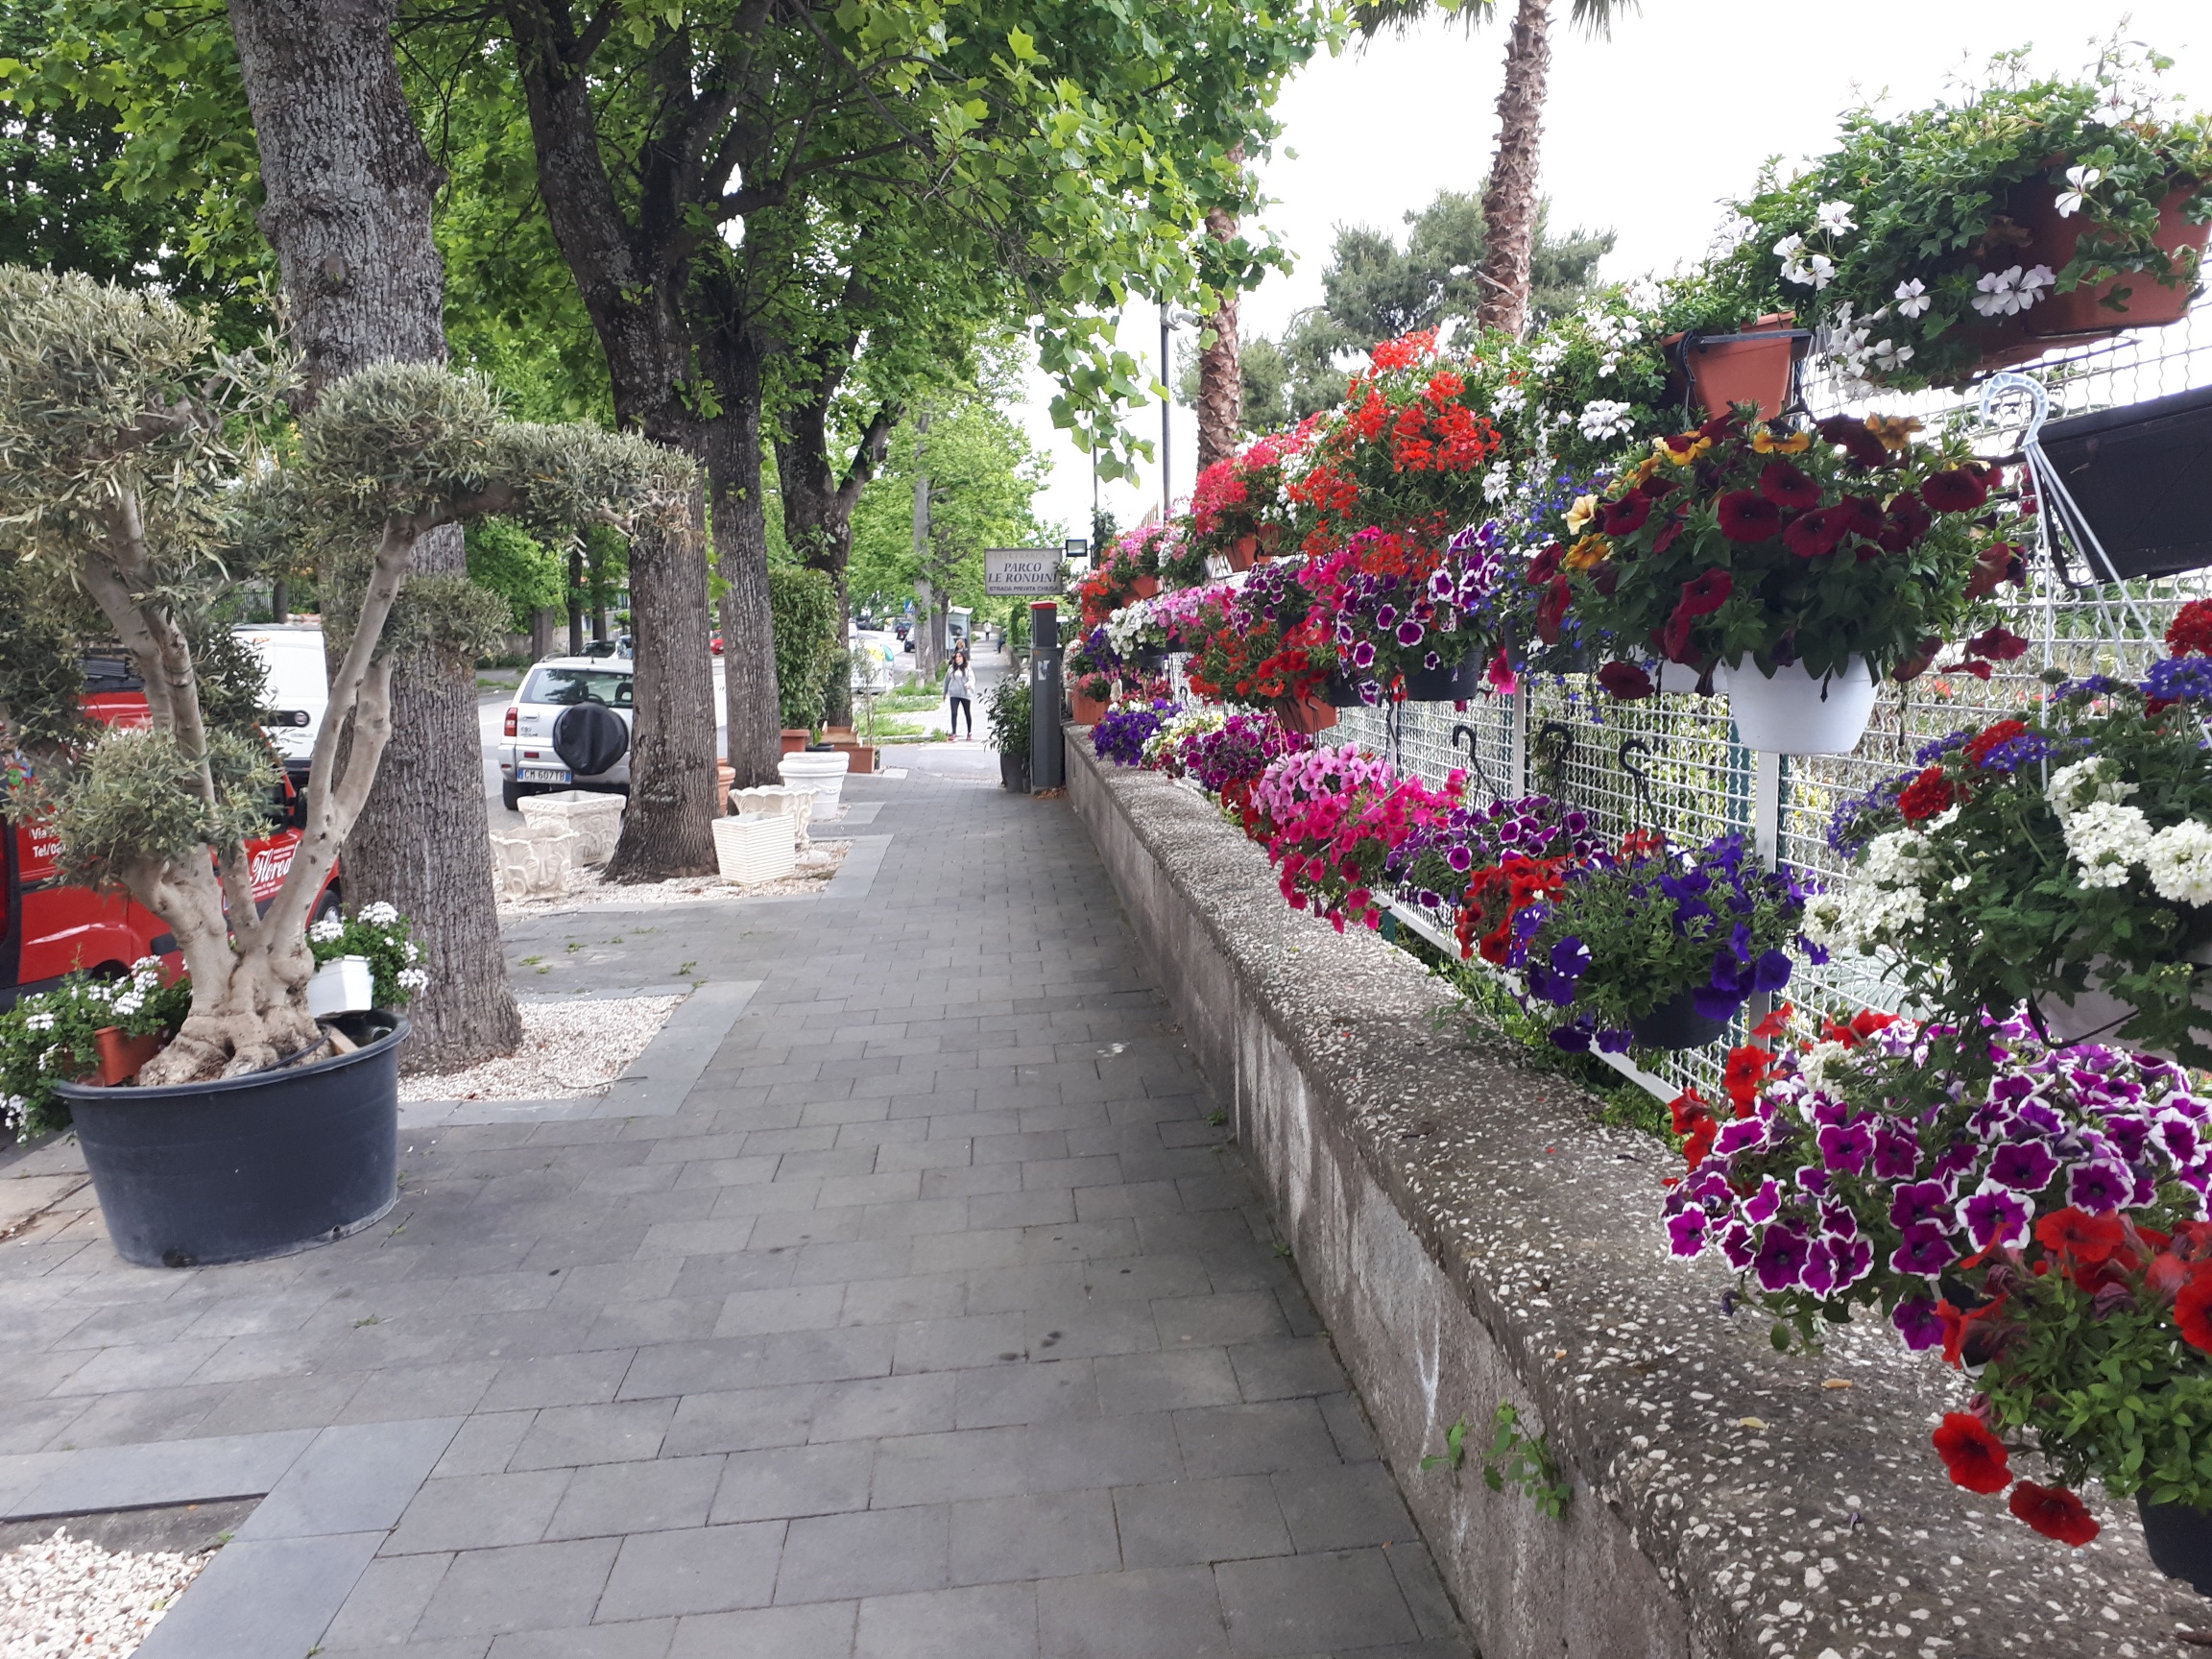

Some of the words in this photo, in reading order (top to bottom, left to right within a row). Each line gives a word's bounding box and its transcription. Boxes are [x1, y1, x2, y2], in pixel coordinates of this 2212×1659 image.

[1003, 563, 1042, 572] PARCO
[988, 573, 1002, 583] LE
[1005, 572, 1057, 583] RONDINI
[31, 827, 47, 840] Via
